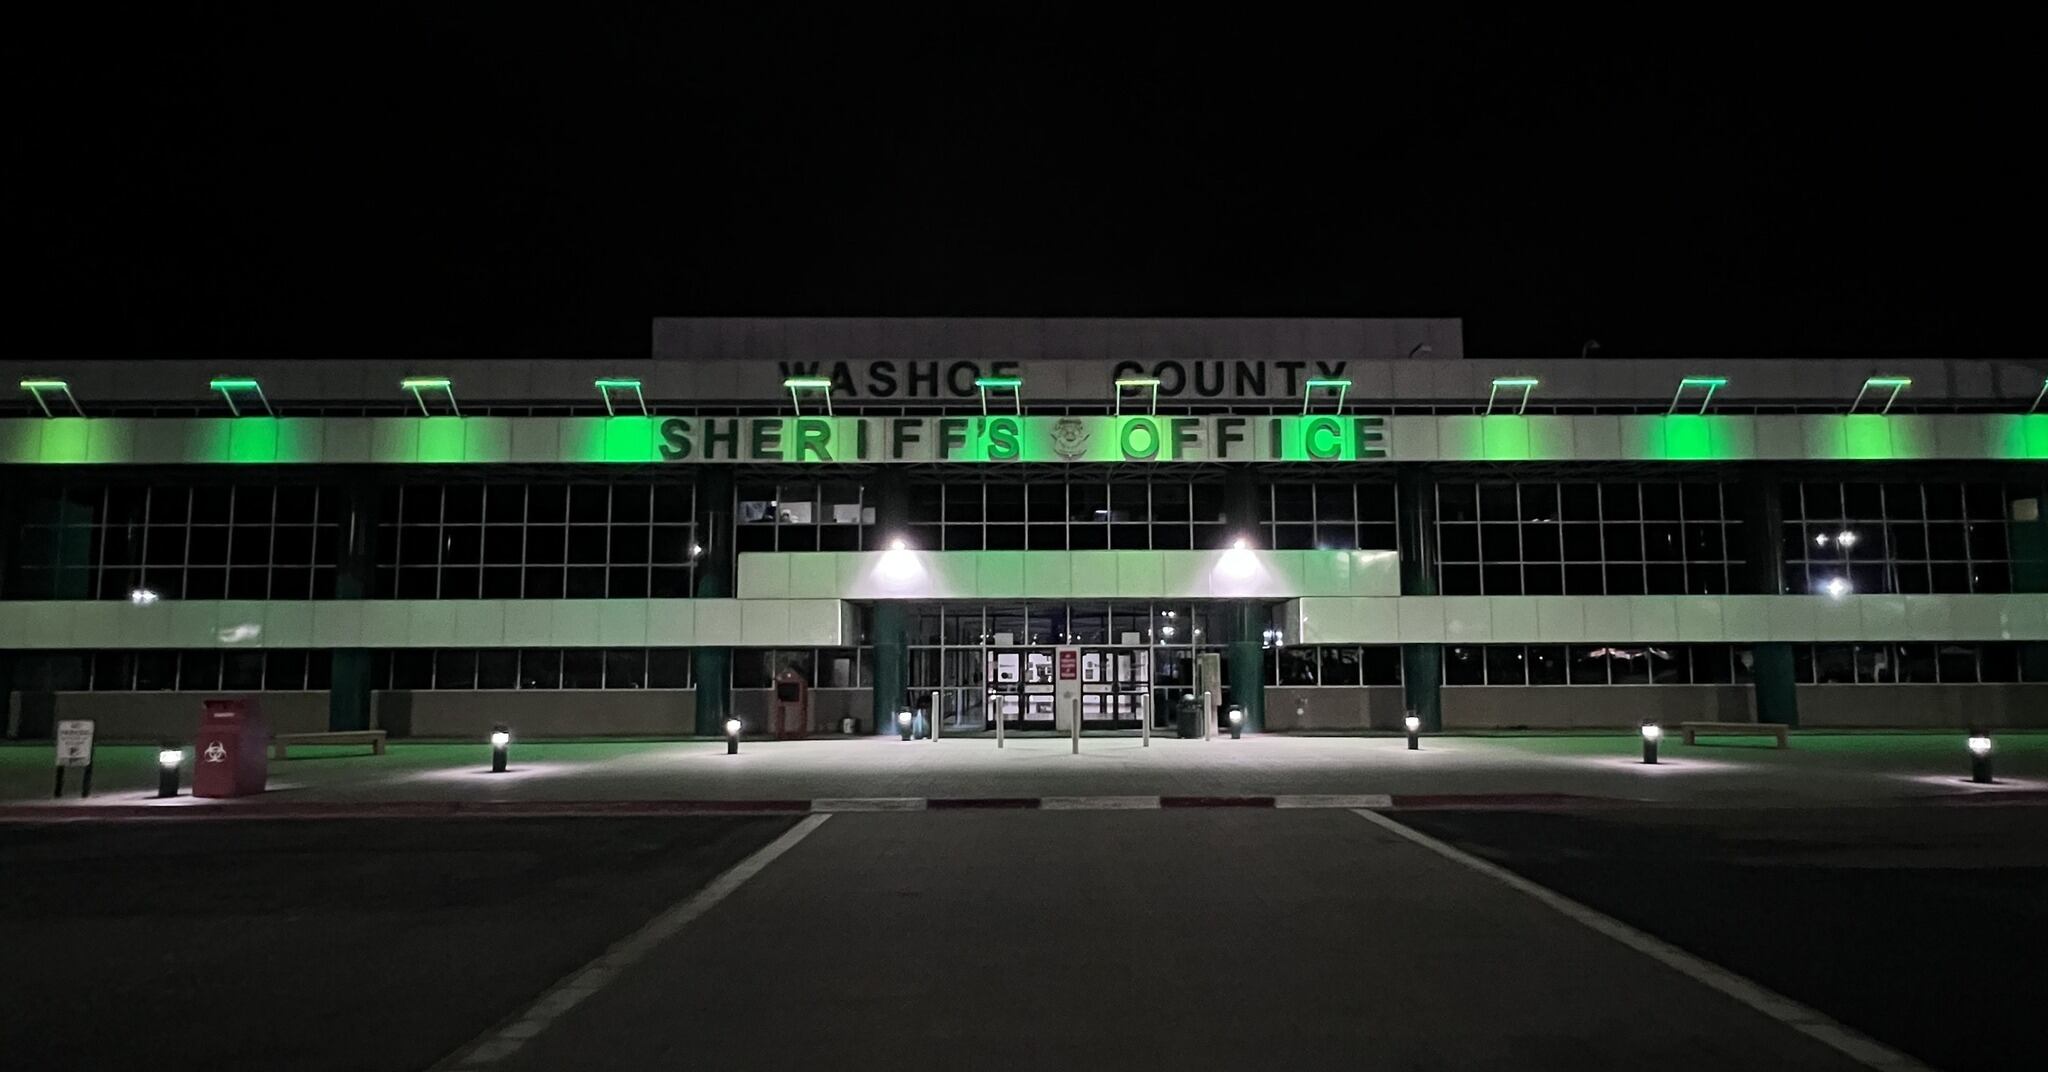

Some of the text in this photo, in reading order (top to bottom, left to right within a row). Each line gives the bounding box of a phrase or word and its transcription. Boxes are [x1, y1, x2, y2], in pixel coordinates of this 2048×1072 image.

[779, 360, 1347, 397] WASHOE COUNTY
[658, 417, 1387, 461] SHERIFF'S OFFICE
